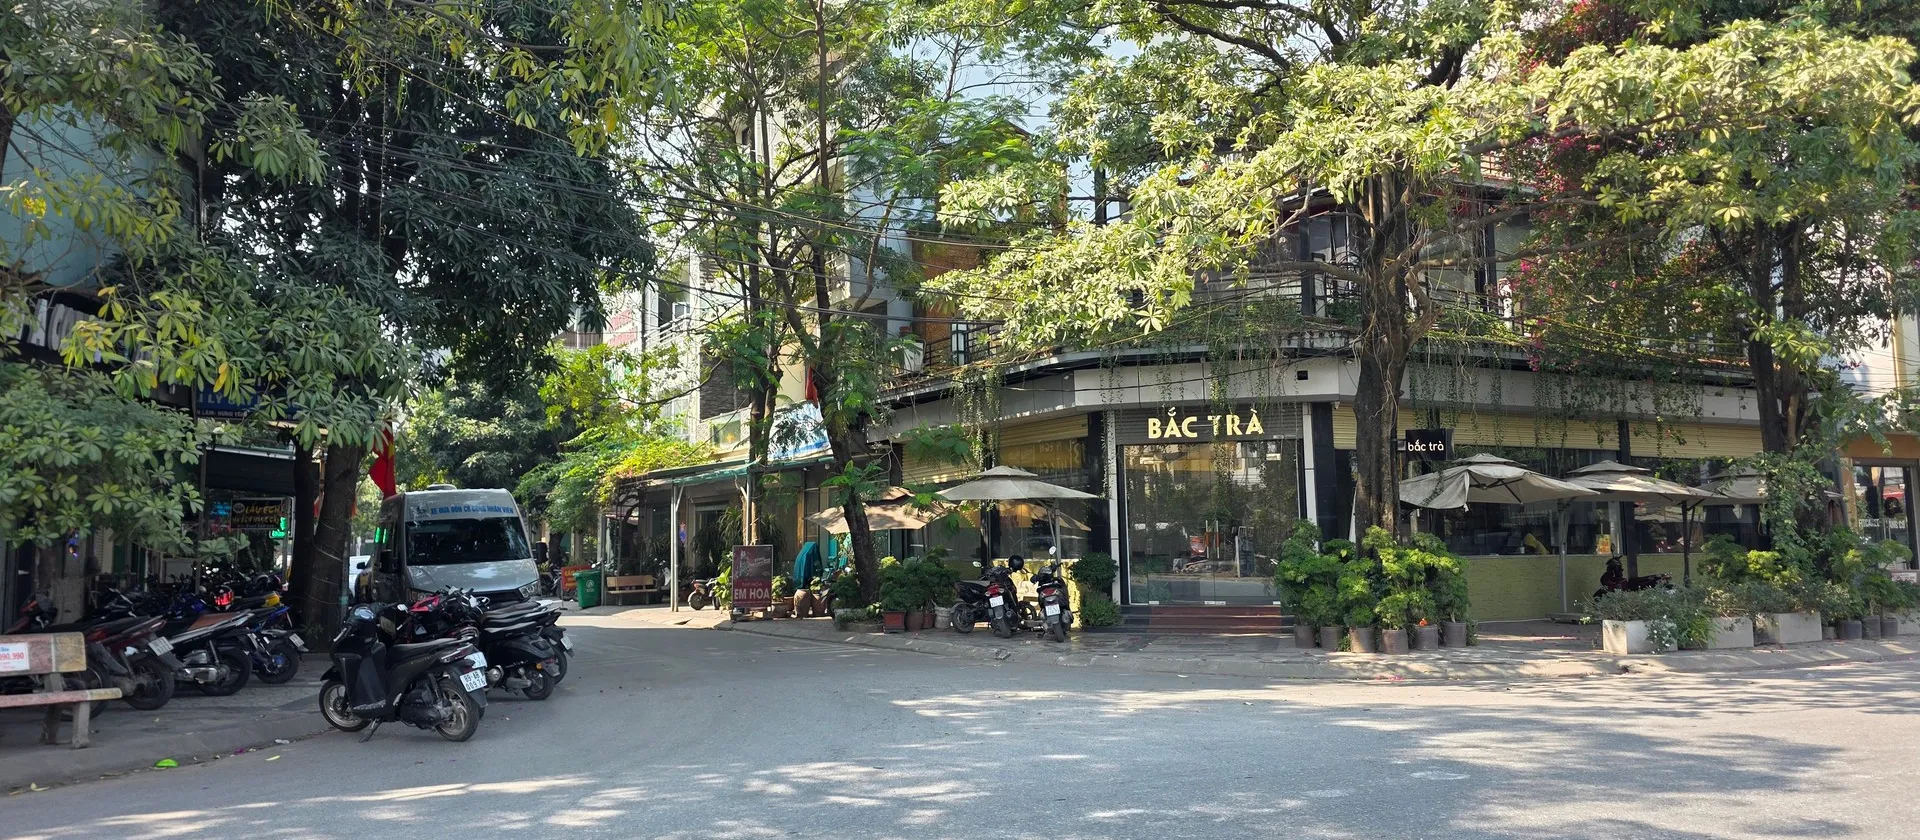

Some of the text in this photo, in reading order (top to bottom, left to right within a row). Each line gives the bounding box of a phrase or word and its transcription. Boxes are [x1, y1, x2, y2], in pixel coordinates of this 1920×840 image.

[1148, 407, 1265, 439] BẮC TRÀ
[1408, 439, 1444, 451] bắc trà
[734, 588, 770, 600] EM HOA
